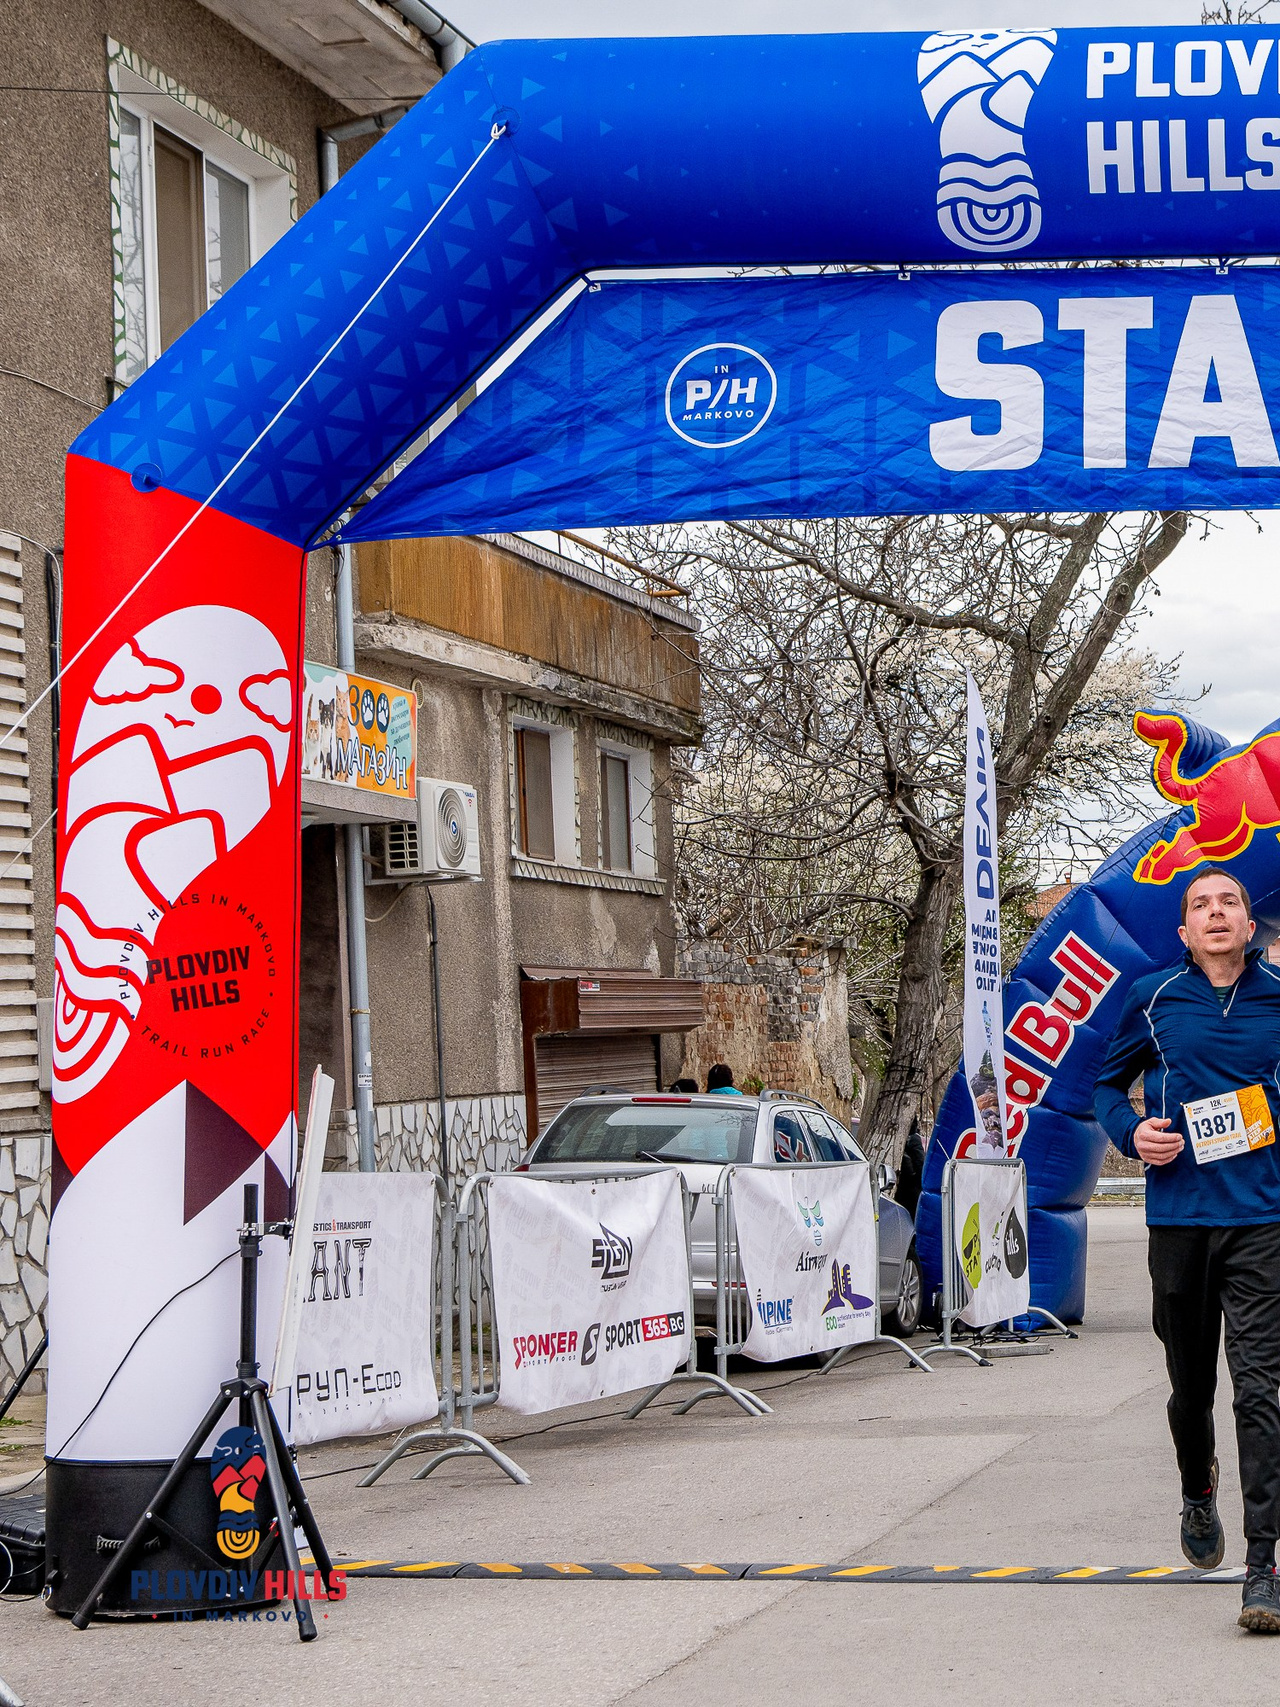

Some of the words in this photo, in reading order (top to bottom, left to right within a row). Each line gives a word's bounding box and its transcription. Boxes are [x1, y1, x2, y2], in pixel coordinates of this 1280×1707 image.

[714, 364, 729, 374] IN
[685, 377, 758, 410] P/H
[682, 410, 754, 421] MARKOVO
[336, 737, 409, 790] МАГАЗИН
[118, 923, 144, 1000] PLOVDIV
[147, 893, 200, 921] HILLS
[211, 893, 229, 907] IN
[236, 903, 276, 977] MARKOVO
[146, 945, 250, 984] PLOVDIV
[170, 979, 240, 1013] HILLS
[1007, 933, 1118, 1065] Bull
[140, 1025, 189, 1057] TRAIL
[200, 1042, 235, 1058] RUN
[241, 1008, 270, 1045] RACE
[1192, 1111, 1236, 1140] 1387
[336, 1220, 372, 1231] TRANSPORT
[303, 1238, 372, 1303] ANT
[825, 1315, 838, 1331] ECO
[513, 1330, 578, 1370] SPONSER
